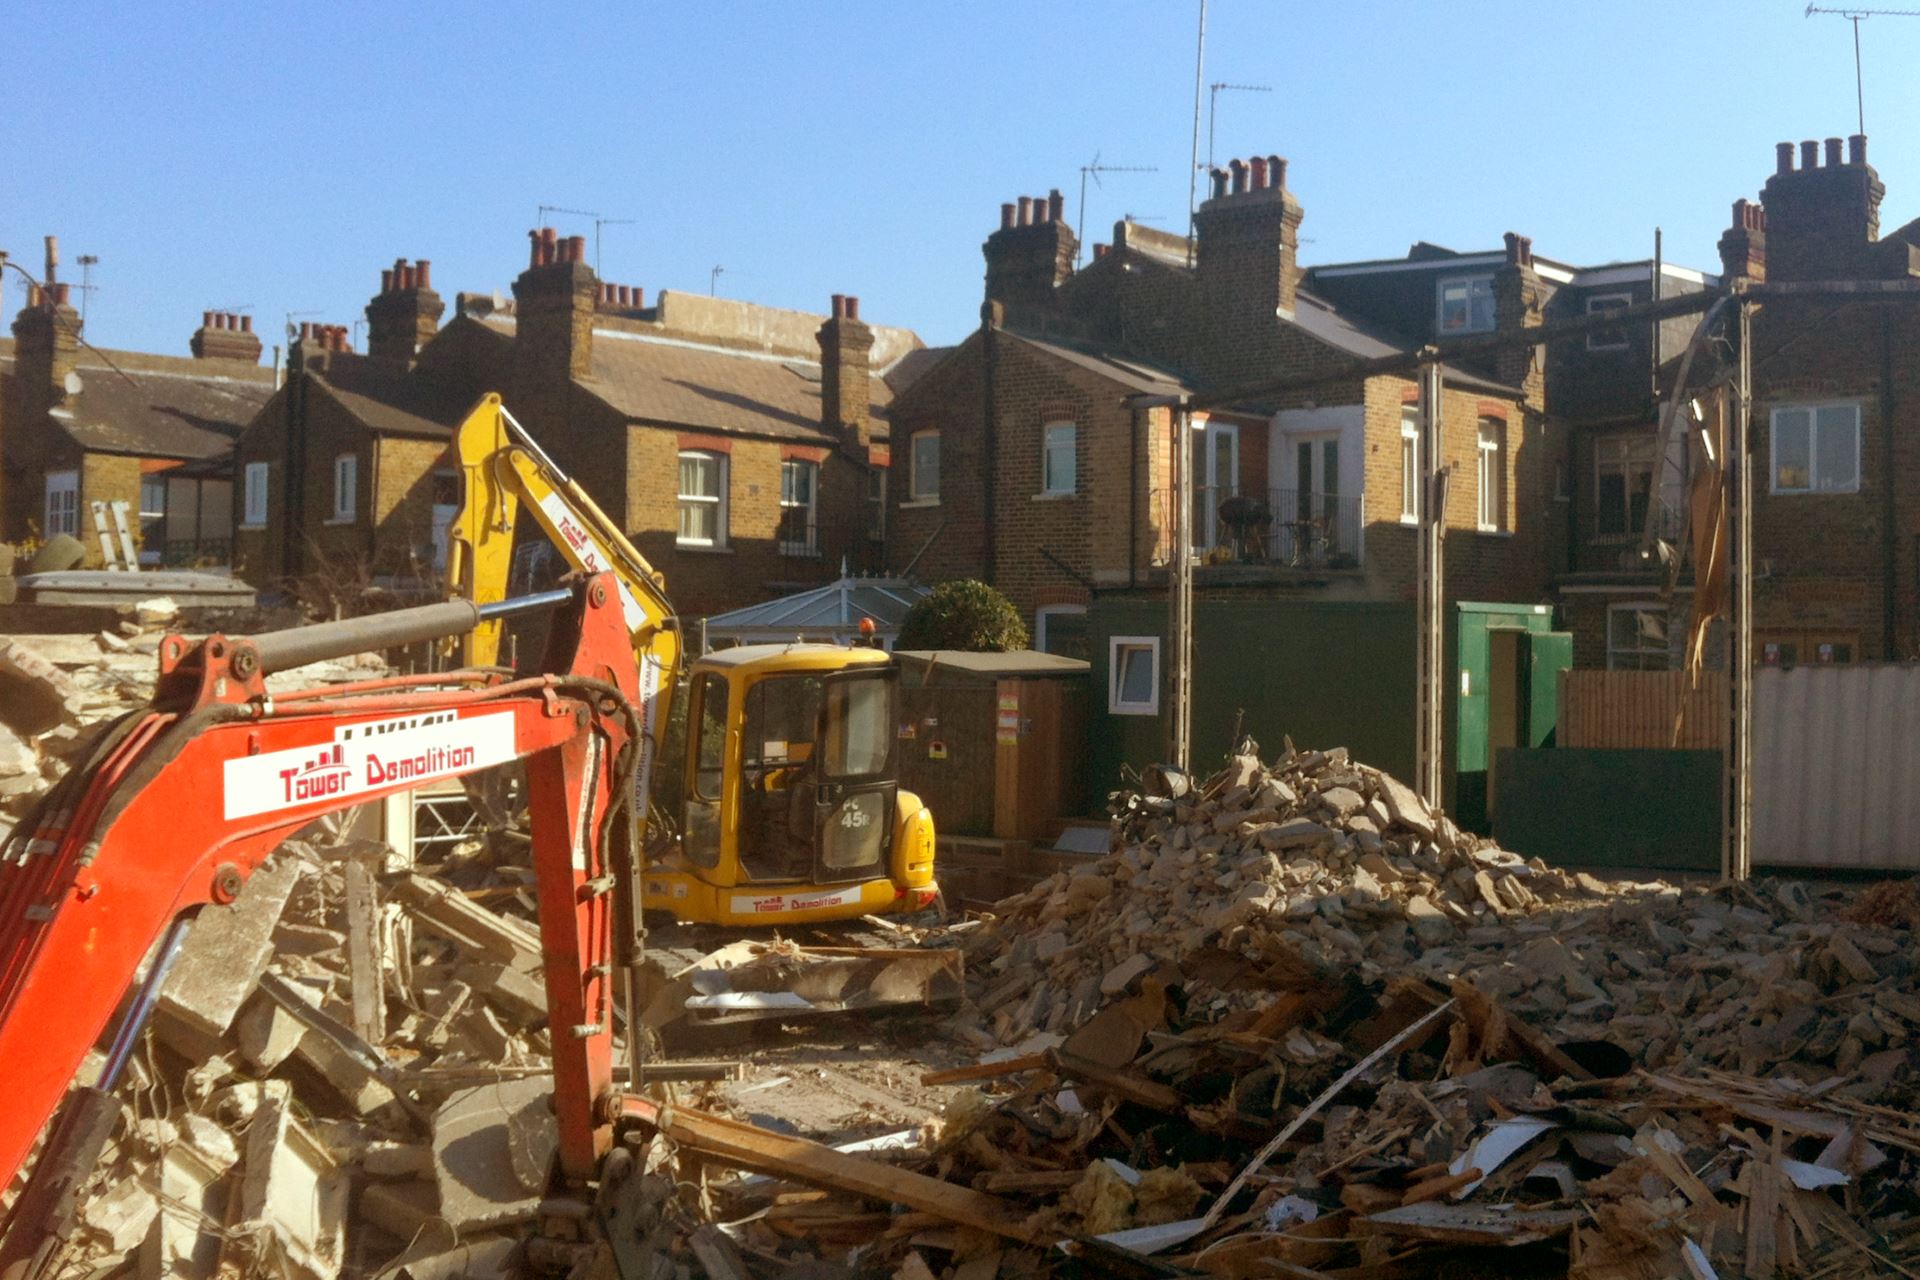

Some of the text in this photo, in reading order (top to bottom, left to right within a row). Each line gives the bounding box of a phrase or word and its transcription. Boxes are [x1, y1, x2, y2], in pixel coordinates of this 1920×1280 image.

[559, 516, 583, 551] Tower
[279, 744, 474, 803] Tower Demolition
[841, 811, 870, 828] 45R
[753, 896, 842, 913] Tower Demolition
